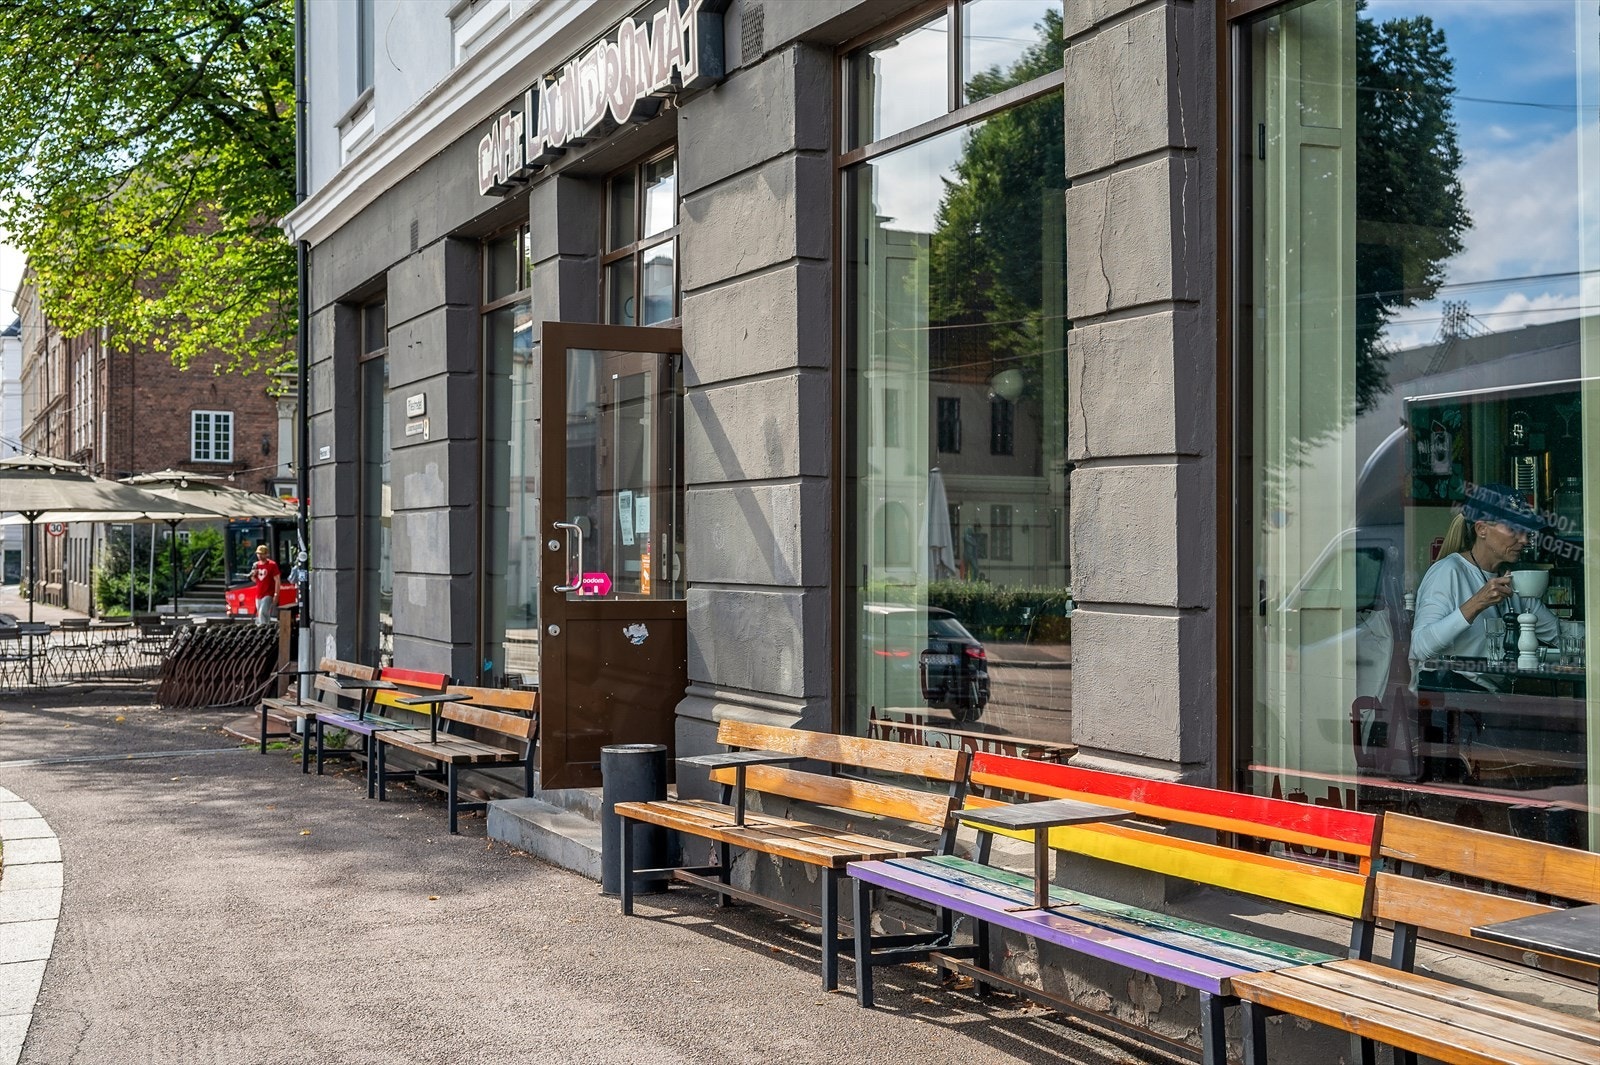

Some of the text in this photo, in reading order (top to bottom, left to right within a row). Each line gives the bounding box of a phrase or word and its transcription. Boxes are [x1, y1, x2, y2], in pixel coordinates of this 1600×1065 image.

[478, 0, 702, 196] CAFE LAUNDROMAT
[51, 524, 62, 533] 30
